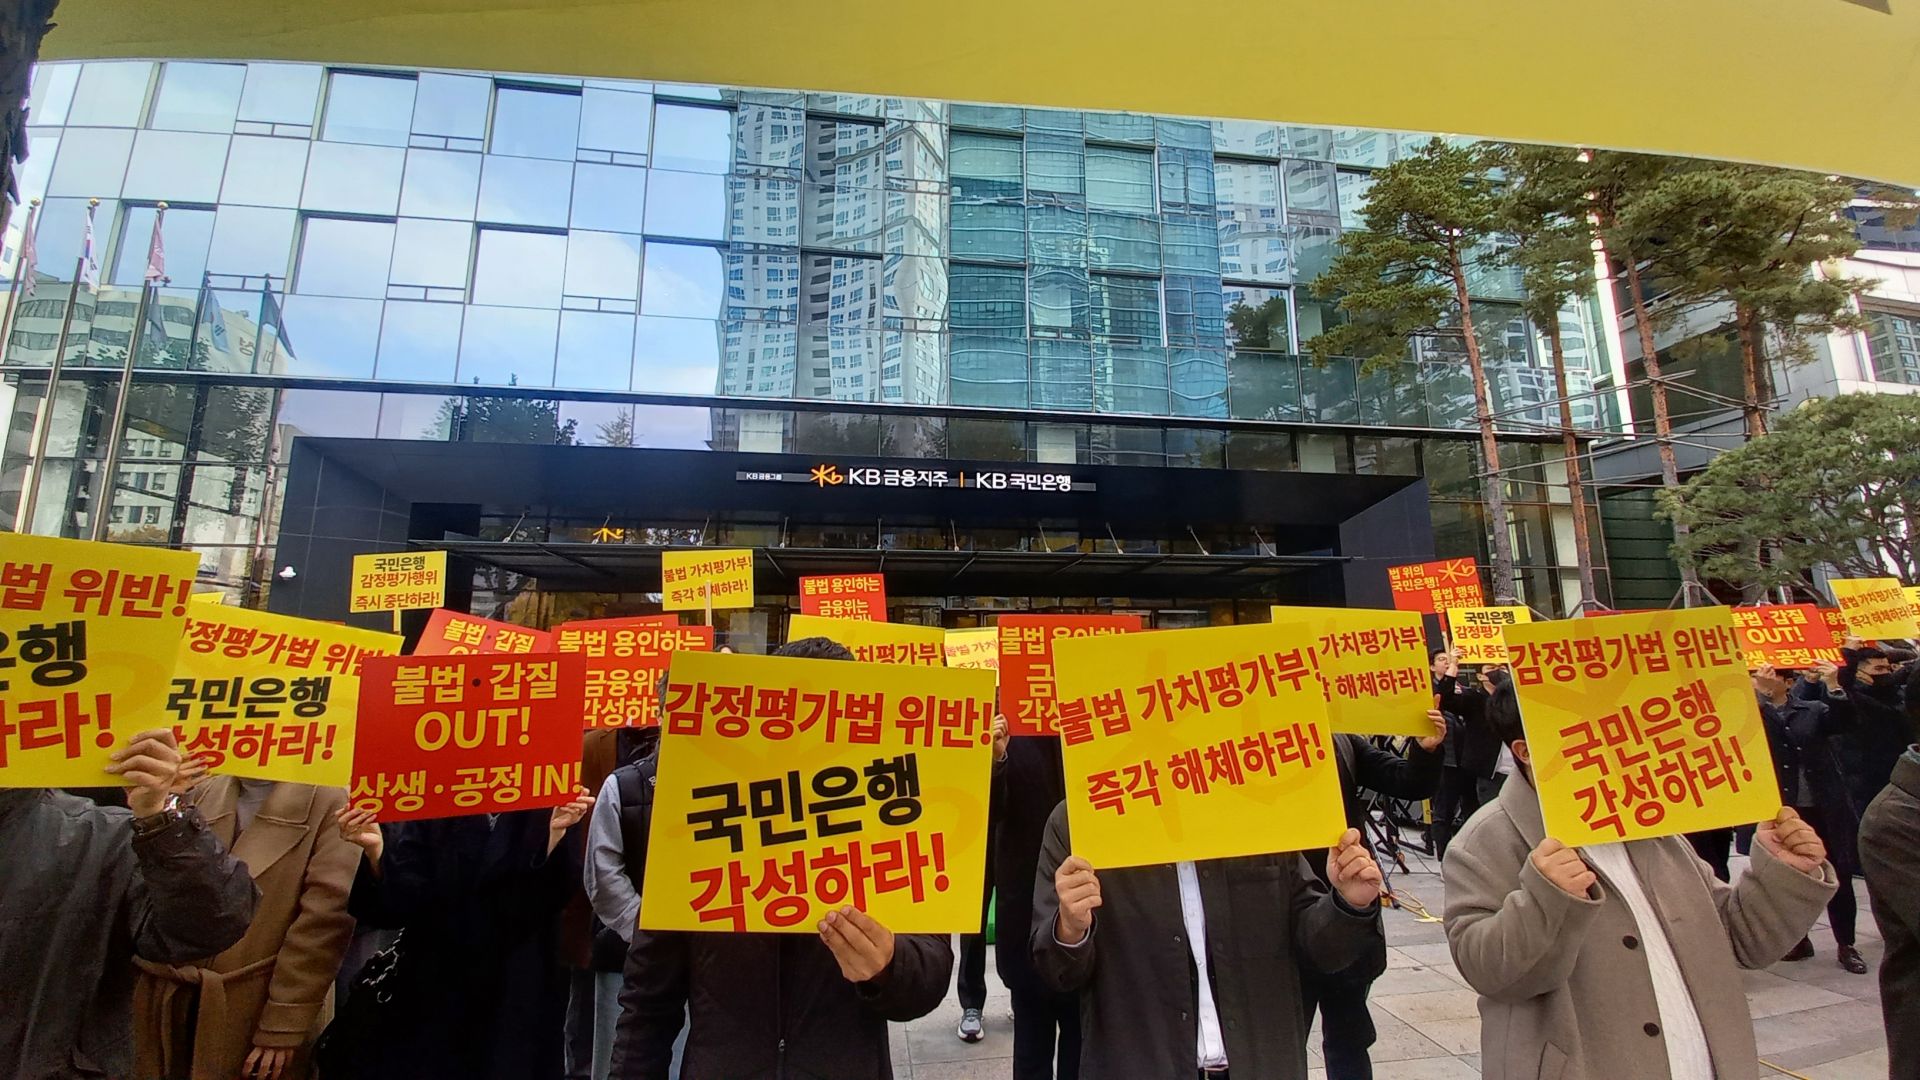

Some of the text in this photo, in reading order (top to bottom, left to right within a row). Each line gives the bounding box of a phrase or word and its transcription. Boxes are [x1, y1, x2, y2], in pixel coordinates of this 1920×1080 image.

[374, 555, 426, 573] 국민은행
[663, 556, 753, 583] 불법 가치평가부!
[1389, 569, 1400, 580] 법
[1403, 565, 1425, 578] 위의
[64, 568, 193, 619] 위반!
[360, 569, 438, 589] 감정평가행위
[803, 576, 881, 595] 불법 용인하는
[1392, 576, 1440, 592] 국민은행!
[1431, 584, 1480, 601] 불법 행위
[355, 591, 440, 610] 즉시 중단하라!
[671, 588, 694, 604] 즉각
[818, 599, 869, 616] 금융위는
[1838, 596, 1860, 609] 불법
[1464, 611, 1516, 625] 국민은행
[1850, 611, 1872, 628] 즉각
[557, 629, 706, 658] 불법 용인하는
[1000, 626, 1044, 655] 불법
[1319, 625, 1427, 659] 가치평가부!
[1745, 625, 1806, 644] OUT!
[1508, 624, 1745, 686] 감정평가법 위반!
[1812, 647, 1844, 663] IN!
[585, 668, 664, 698] 금융위
[1058, 646, 1322, 747] 불법 가치평가부!
[1335, 667, 1427, 699] 해체하라!
[166, 676, 332, 721] 국민은행
[414, 706, 531, 752] OUT!
[664, 681, 993, 748] 감정평가법 위반!
[1559, 679, 1722, 777] 국민은행
[0, 691, 116, 769] 라!
[174, 721, 338, 769] 성하라!
[532, 761, 583, 797] IN!
[1086, 722, 1326, 816] 즉각 해체하라!
[1573, 735, 1753, 838] 각성하라!
[686, 752, 923, 854] 국민은행
[689, 830, 950, 932] 각성하라!
